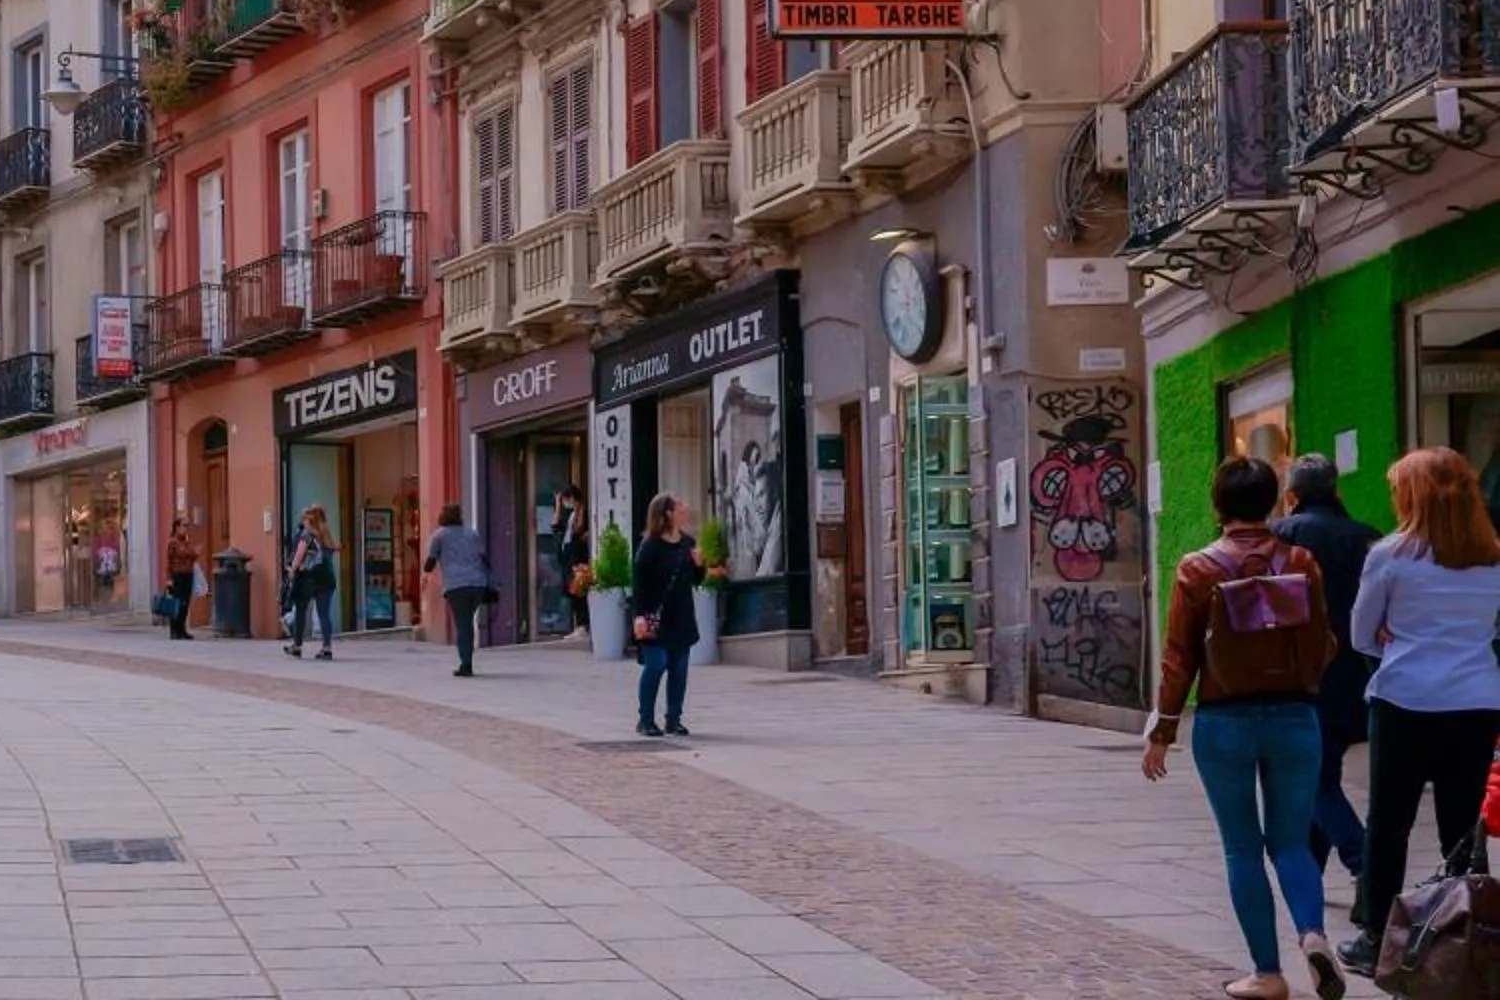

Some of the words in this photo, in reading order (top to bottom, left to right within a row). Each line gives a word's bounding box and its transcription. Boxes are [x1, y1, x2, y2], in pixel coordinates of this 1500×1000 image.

[783, 4, 857, 26] TIMBRI
[876, 4, 960, 26] TARGHE
[611, 352, 670, 392] Arianna
[689, 309, 763, 363] OUTLET
[284, 362, 395, 427] TEZENIS
[493, 360, 557, 406] CROFF
